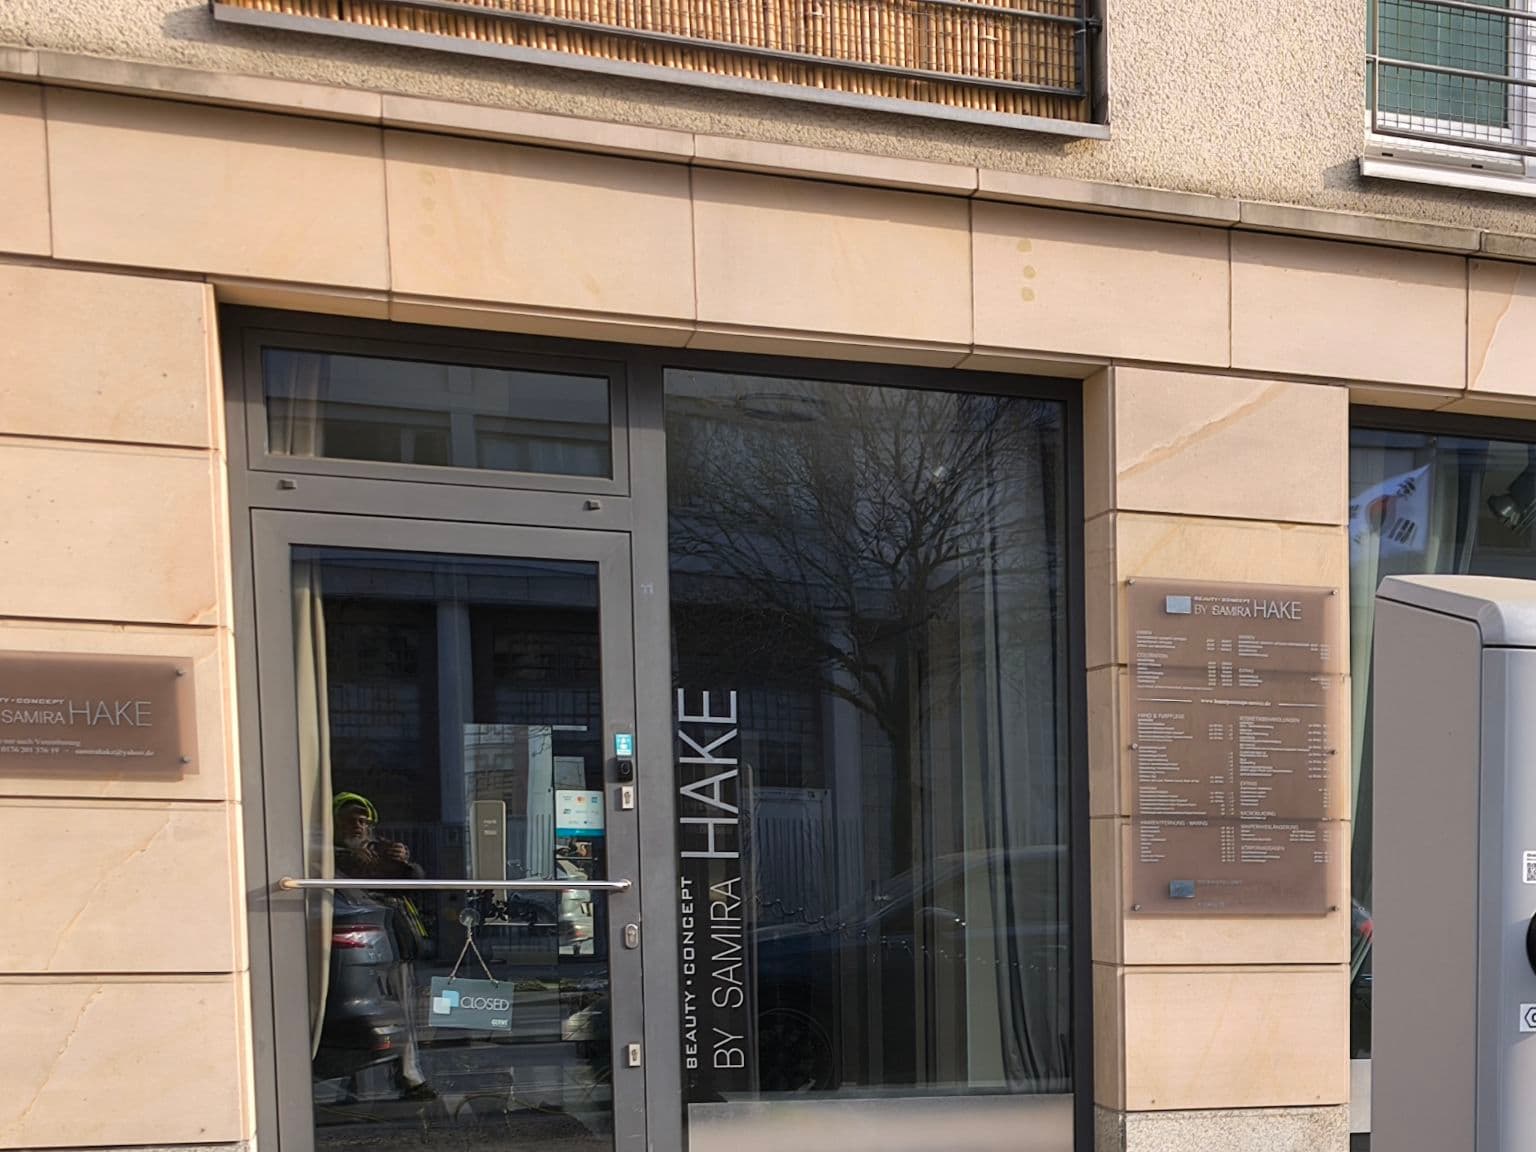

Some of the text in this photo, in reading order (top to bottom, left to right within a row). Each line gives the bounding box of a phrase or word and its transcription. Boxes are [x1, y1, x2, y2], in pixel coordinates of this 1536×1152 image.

[1194, 604, 1208, 615] BY
[1212, 604, 1251, 617] SAMIRA
[1253, 600, 1302, 620] HAKE
[1, 700, 152, 727] SAMIRA HAKE
[677, 687, 745, 1069] BY SAMIRA HAKE
[681, 876, 698, 1069] BEAUTY CONCEPT
[460, 996, 510, 1011] CLOSED
